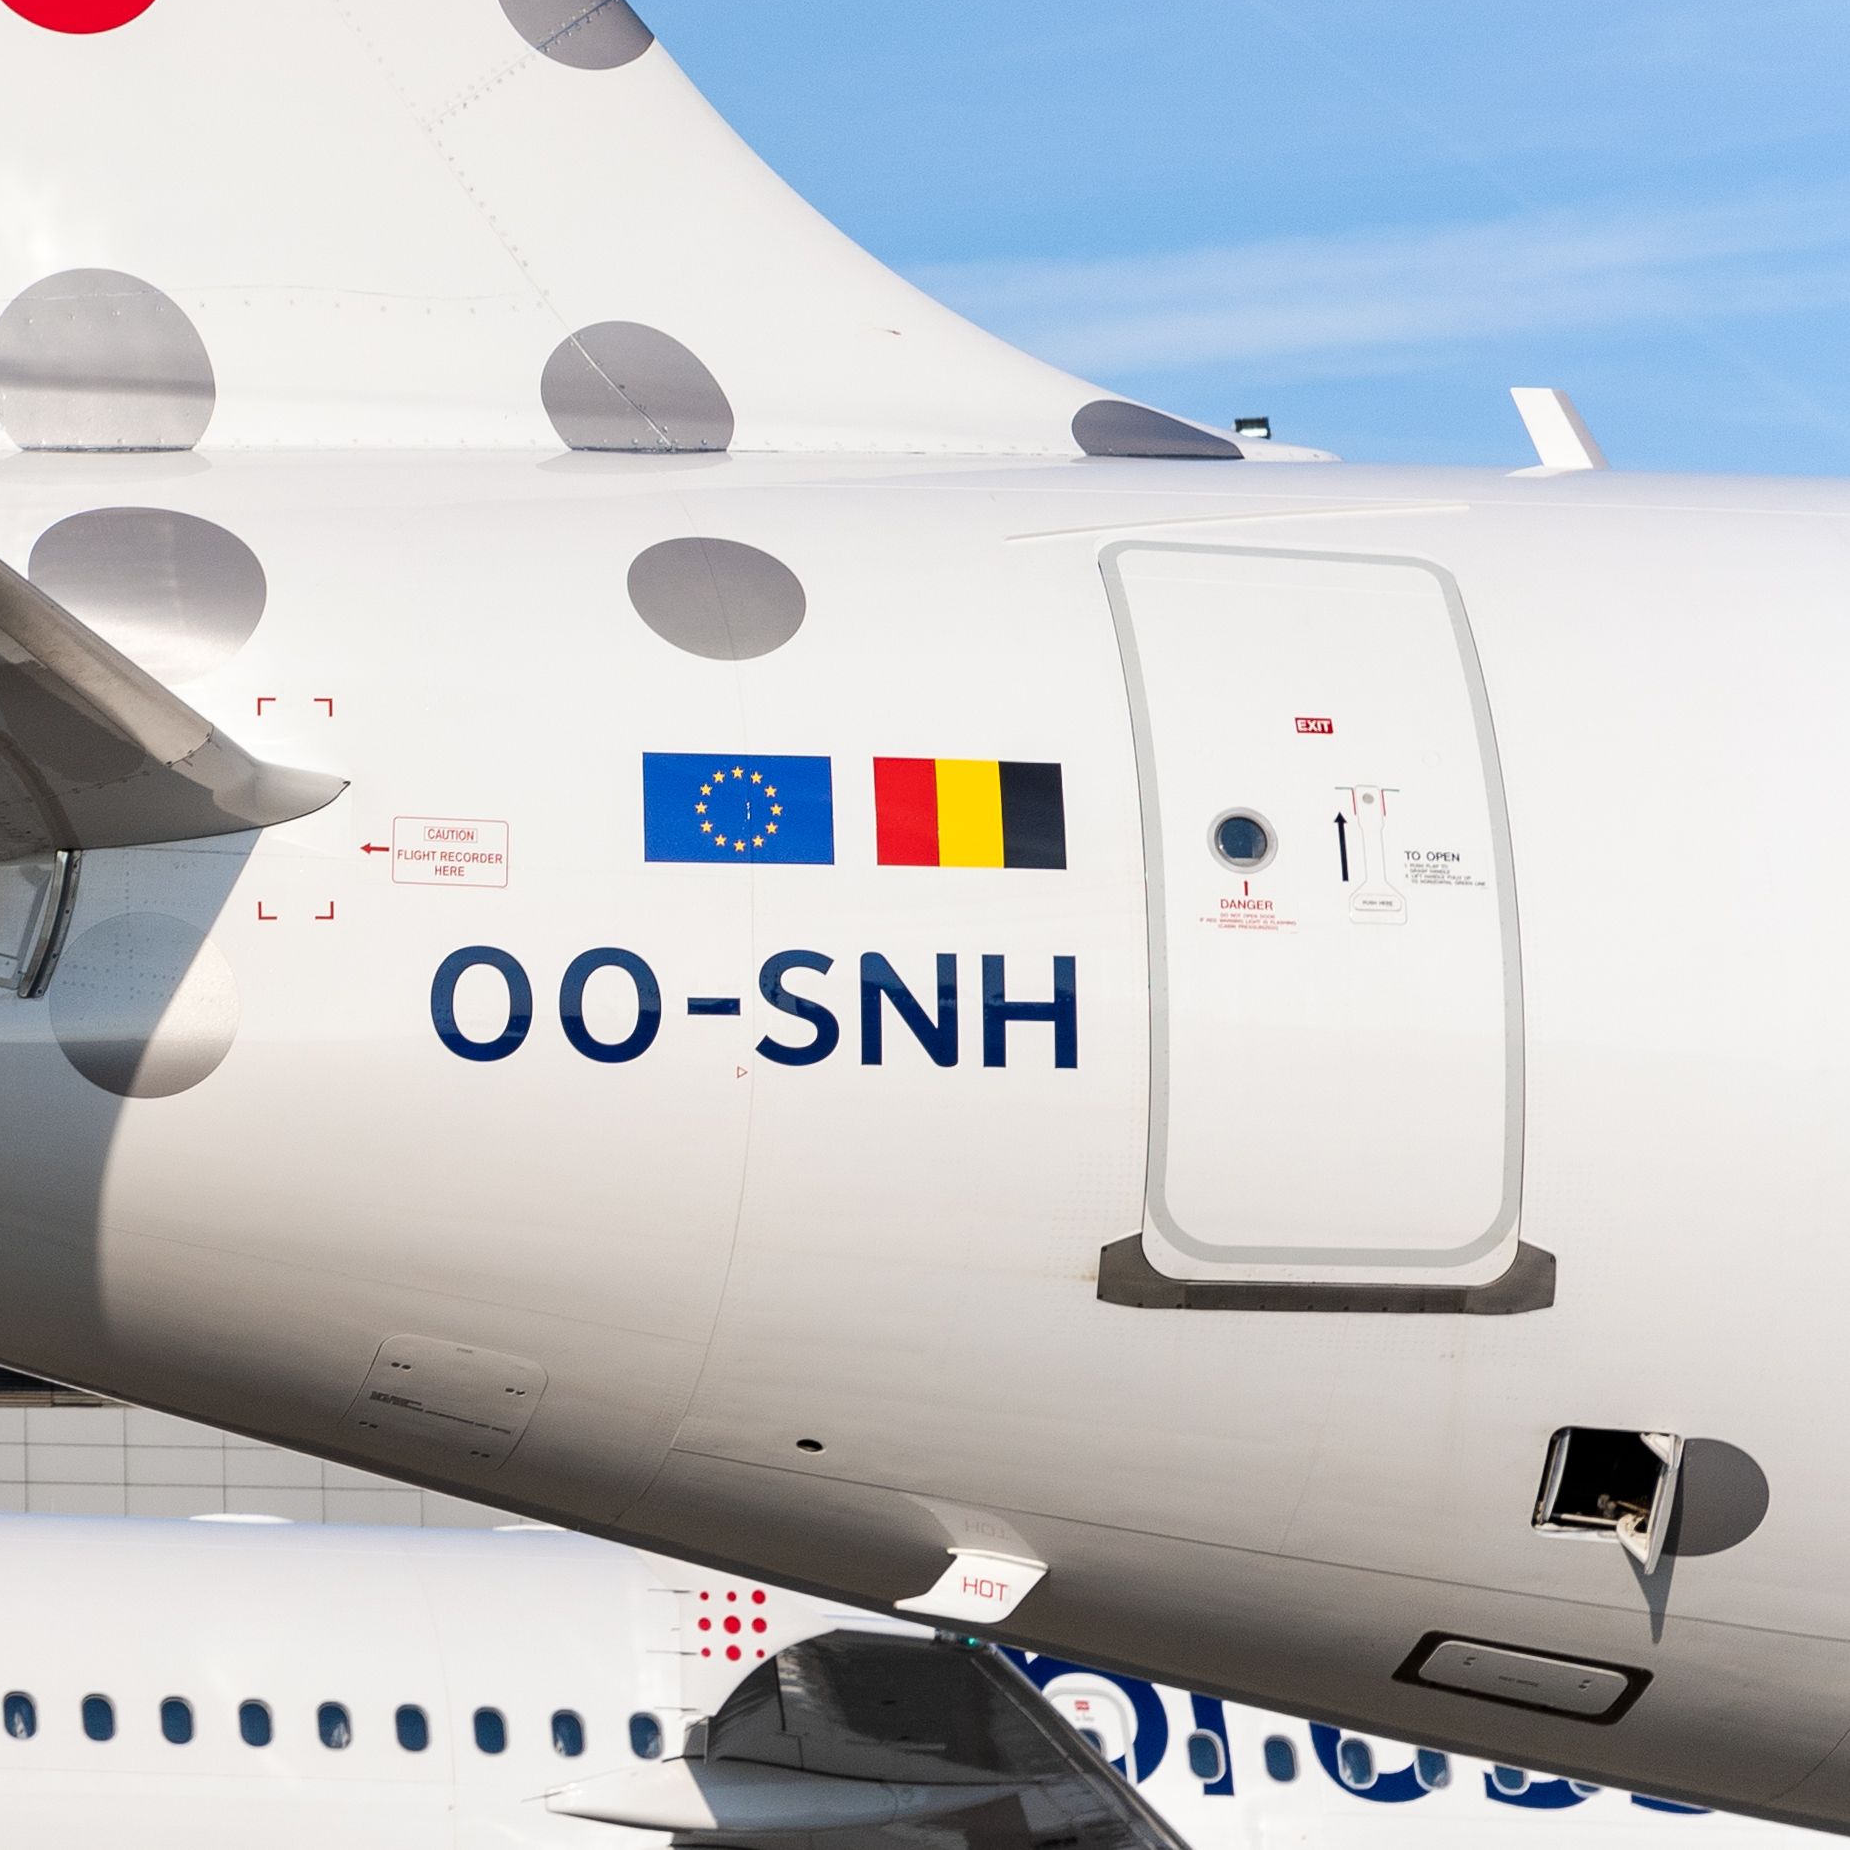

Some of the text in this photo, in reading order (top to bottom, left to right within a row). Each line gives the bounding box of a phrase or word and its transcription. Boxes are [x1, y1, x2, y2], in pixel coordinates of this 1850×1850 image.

[1297, 719, 1330, 733] EXIT
[427, 828, 474, 841] CAUTION
[397, 849, 503, 864] FLIGHT RECORDER
[1404, 851, 1460, 862] TO OPEN
[434, 866, 465, 877] HERE
[1220, 898, 1273, 910] DANGER
[431, 945, 1077, 1068] OO-SNH
[963, 1576, 1008, 1602] HOT
